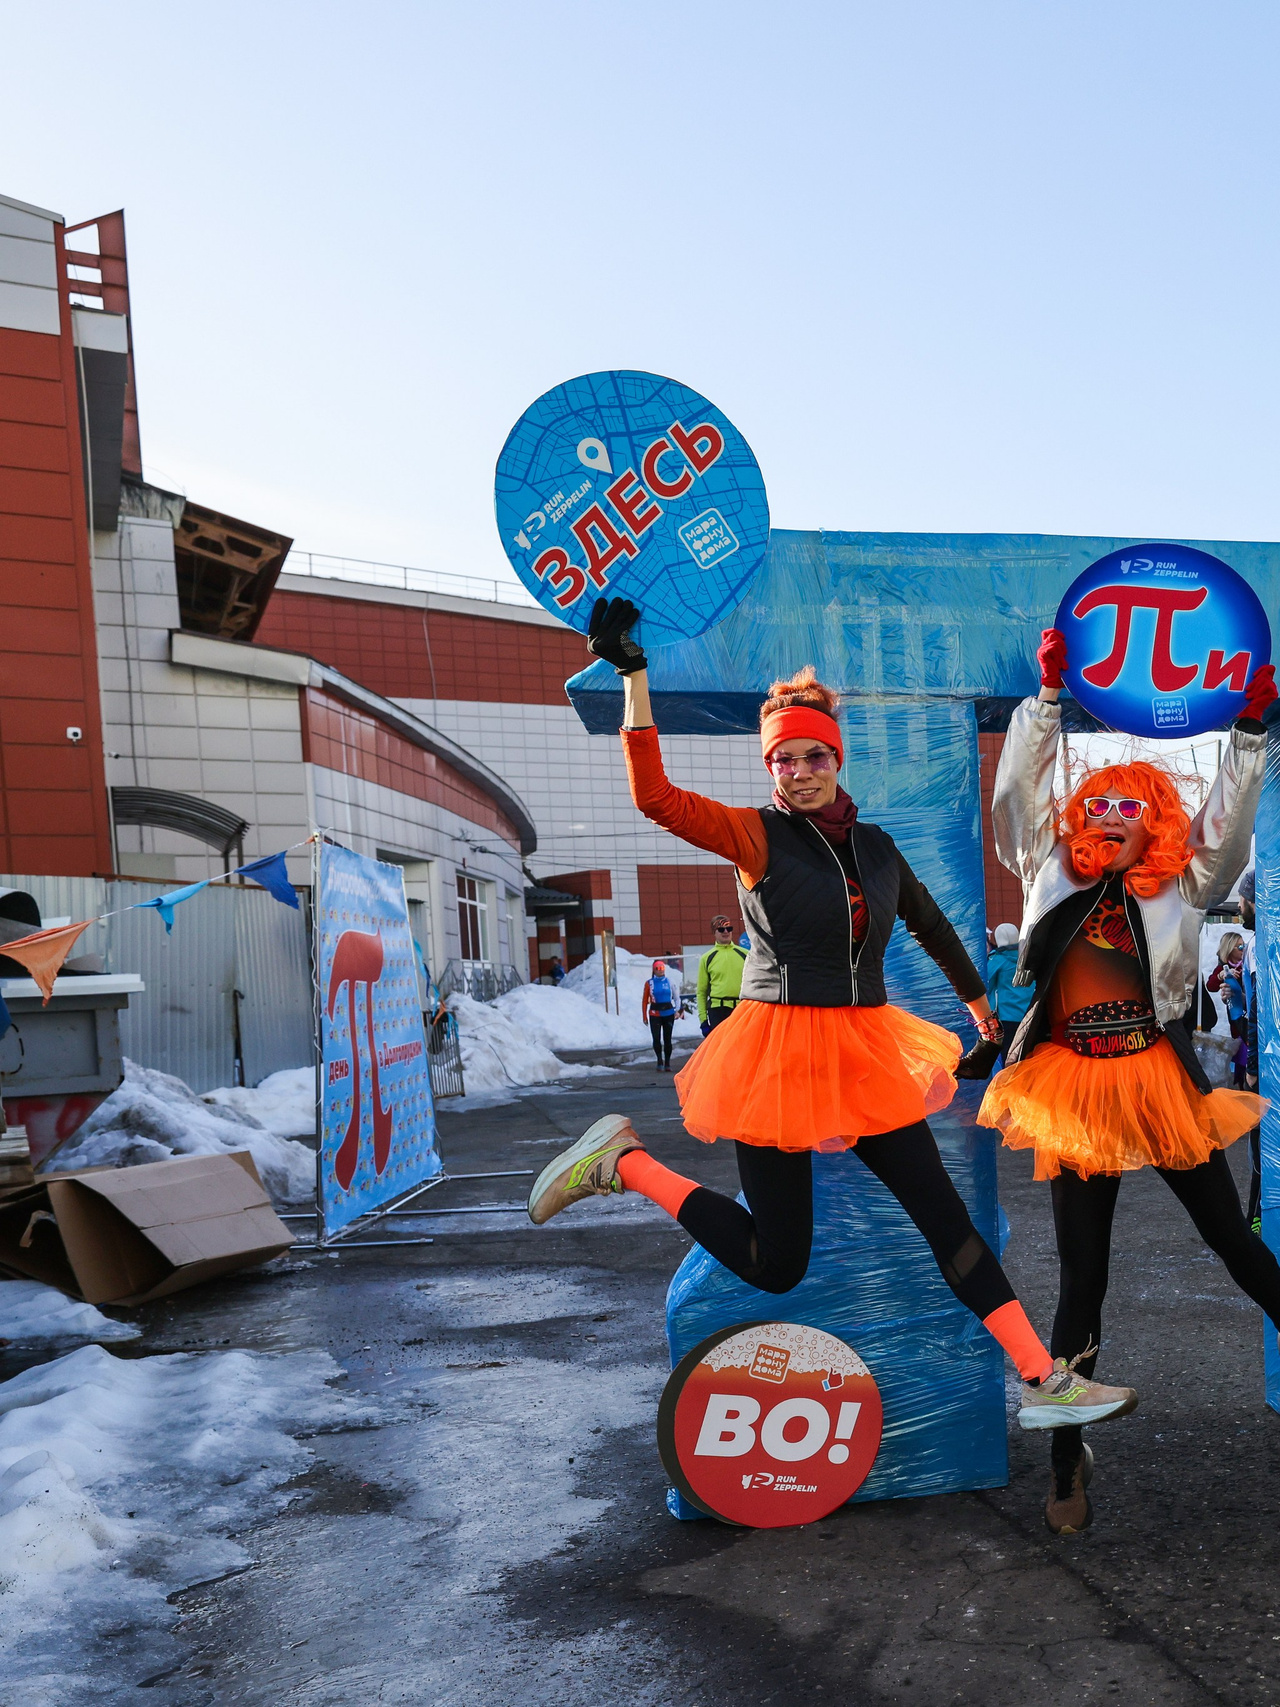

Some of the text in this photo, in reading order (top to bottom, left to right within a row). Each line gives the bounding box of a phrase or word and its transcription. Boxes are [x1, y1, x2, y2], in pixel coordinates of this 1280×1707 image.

[543, 490, 565, 514] RUN
[550, 479, 593, 525] ZEPPELIN
[531, 419, 725, 610] ЗДЕСЬ
[684, 516, 718, 542] мара
[693, 524, 726, 551] фону
[698, 535, 732, 564] дома
[1156, 561, 1176, 570] RUN
[1153, 569, 1199, 579] ZEPPELIN
[1156, 699, 1183, 708] мара
[1157, 706, 1184, 716] фону
[1157, 714, 1185, 724] дома
[328, 1059, 349, 1086] день
[759, 1347, 787, 1360] мара
[756, 1356, 786, 1369] фону
[753, 1364, 782, 1377] дома
[693, 1393, 862, 1464] ВО!
[776, 1475, 797, 1483] RUN
[773, 1483, 818, 1493] ZEPPELIN
